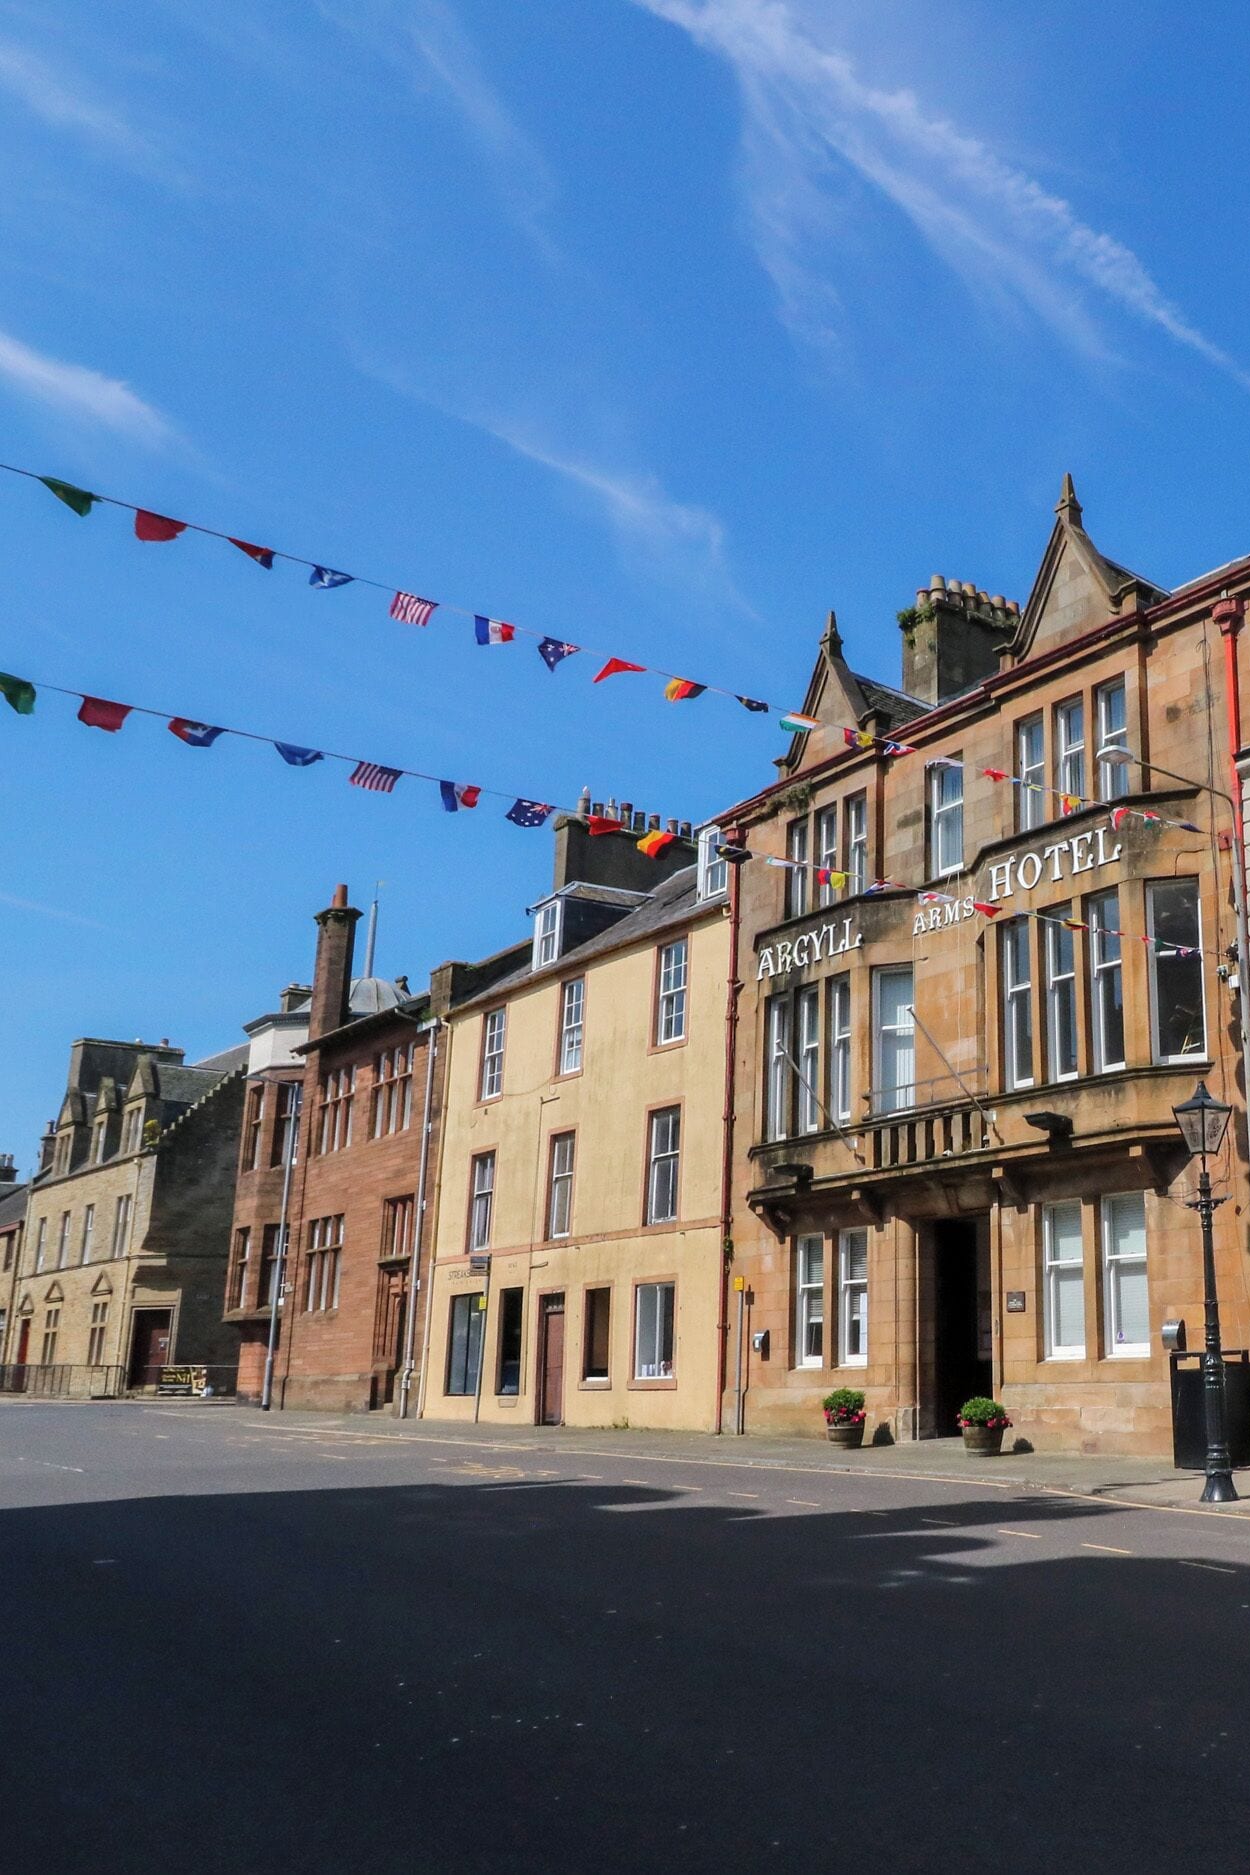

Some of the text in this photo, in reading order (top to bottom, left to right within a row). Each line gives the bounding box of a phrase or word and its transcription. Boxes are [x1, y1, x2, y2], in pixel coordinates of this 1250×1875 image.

[755, 826, 1123, 981] ARGYLL ARMS HOTEL
